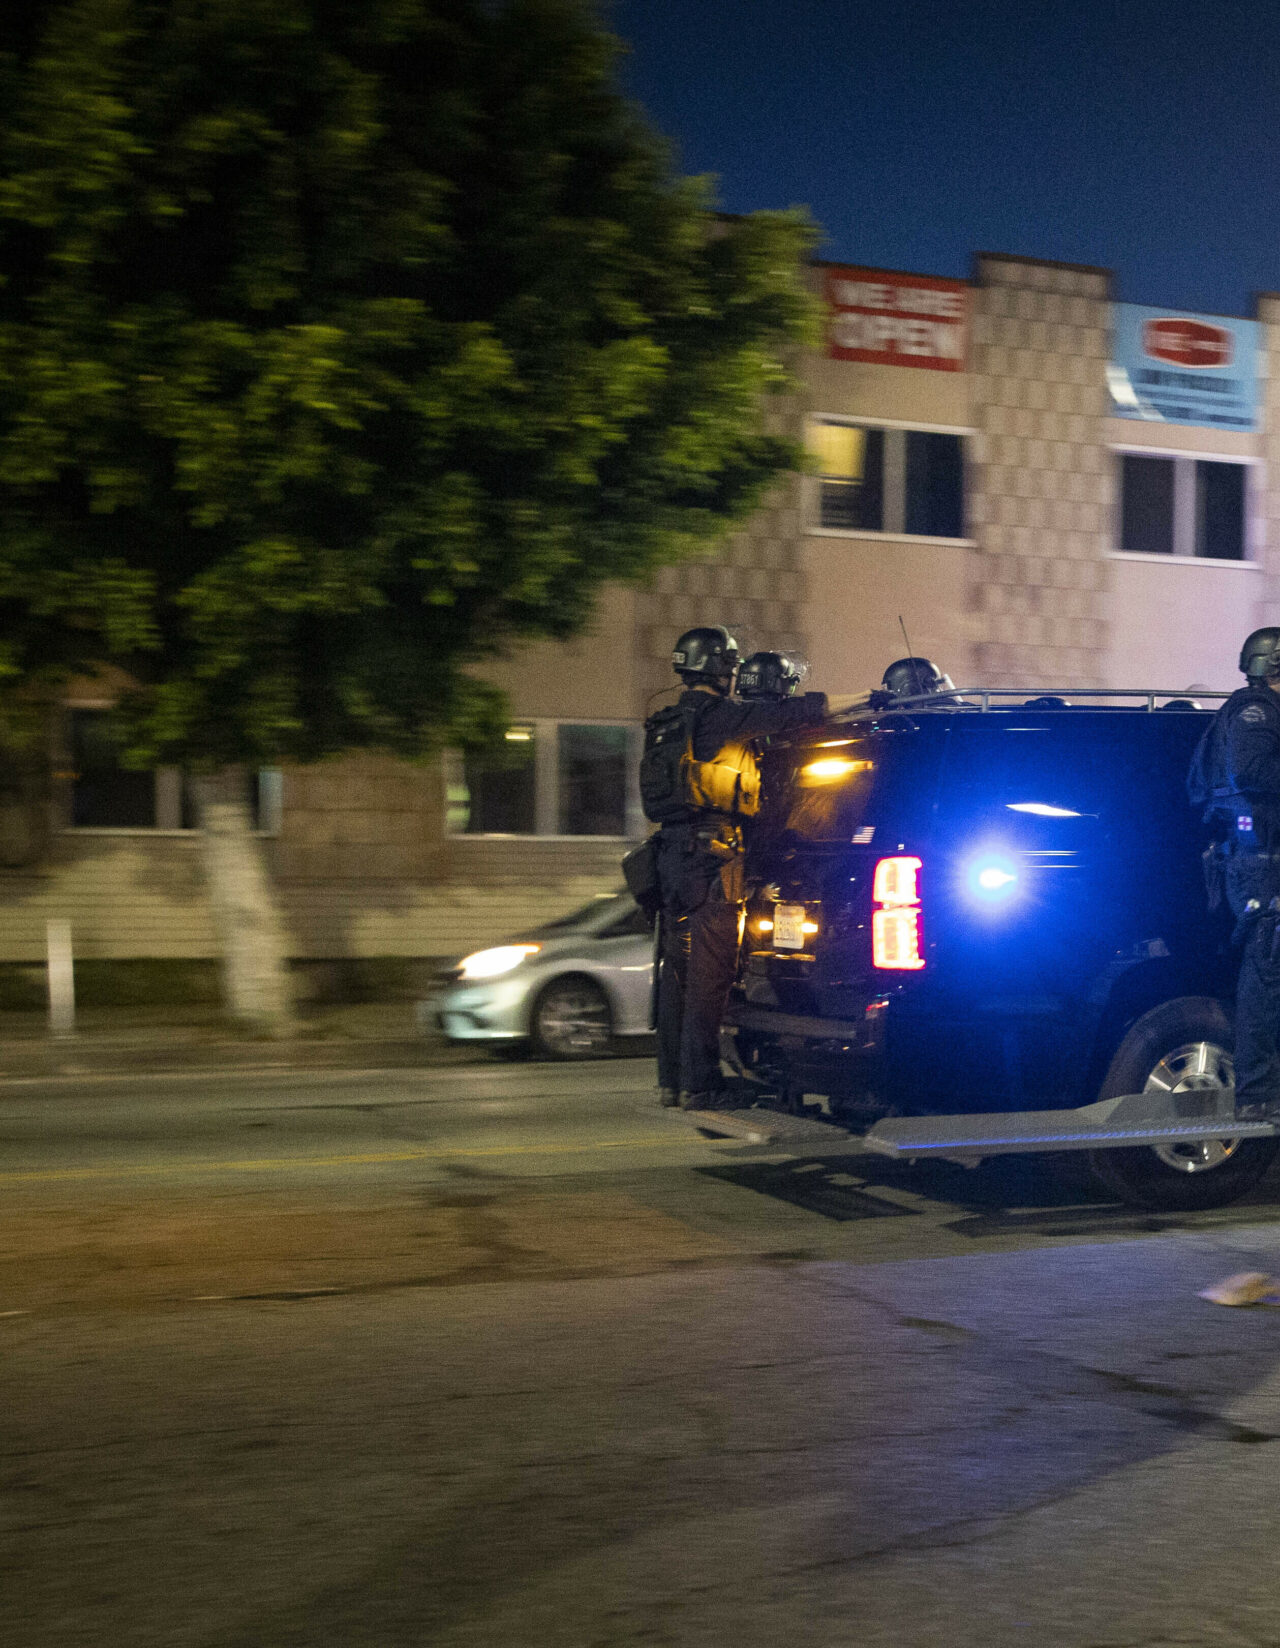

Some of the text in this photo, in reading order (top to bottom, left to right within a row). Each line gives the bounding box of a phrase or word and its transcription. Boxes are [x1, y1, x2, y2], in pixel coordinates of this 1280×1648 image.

[834, 279, 963, 318] WE ARE
[835, 312, 964, 360] OPEN
